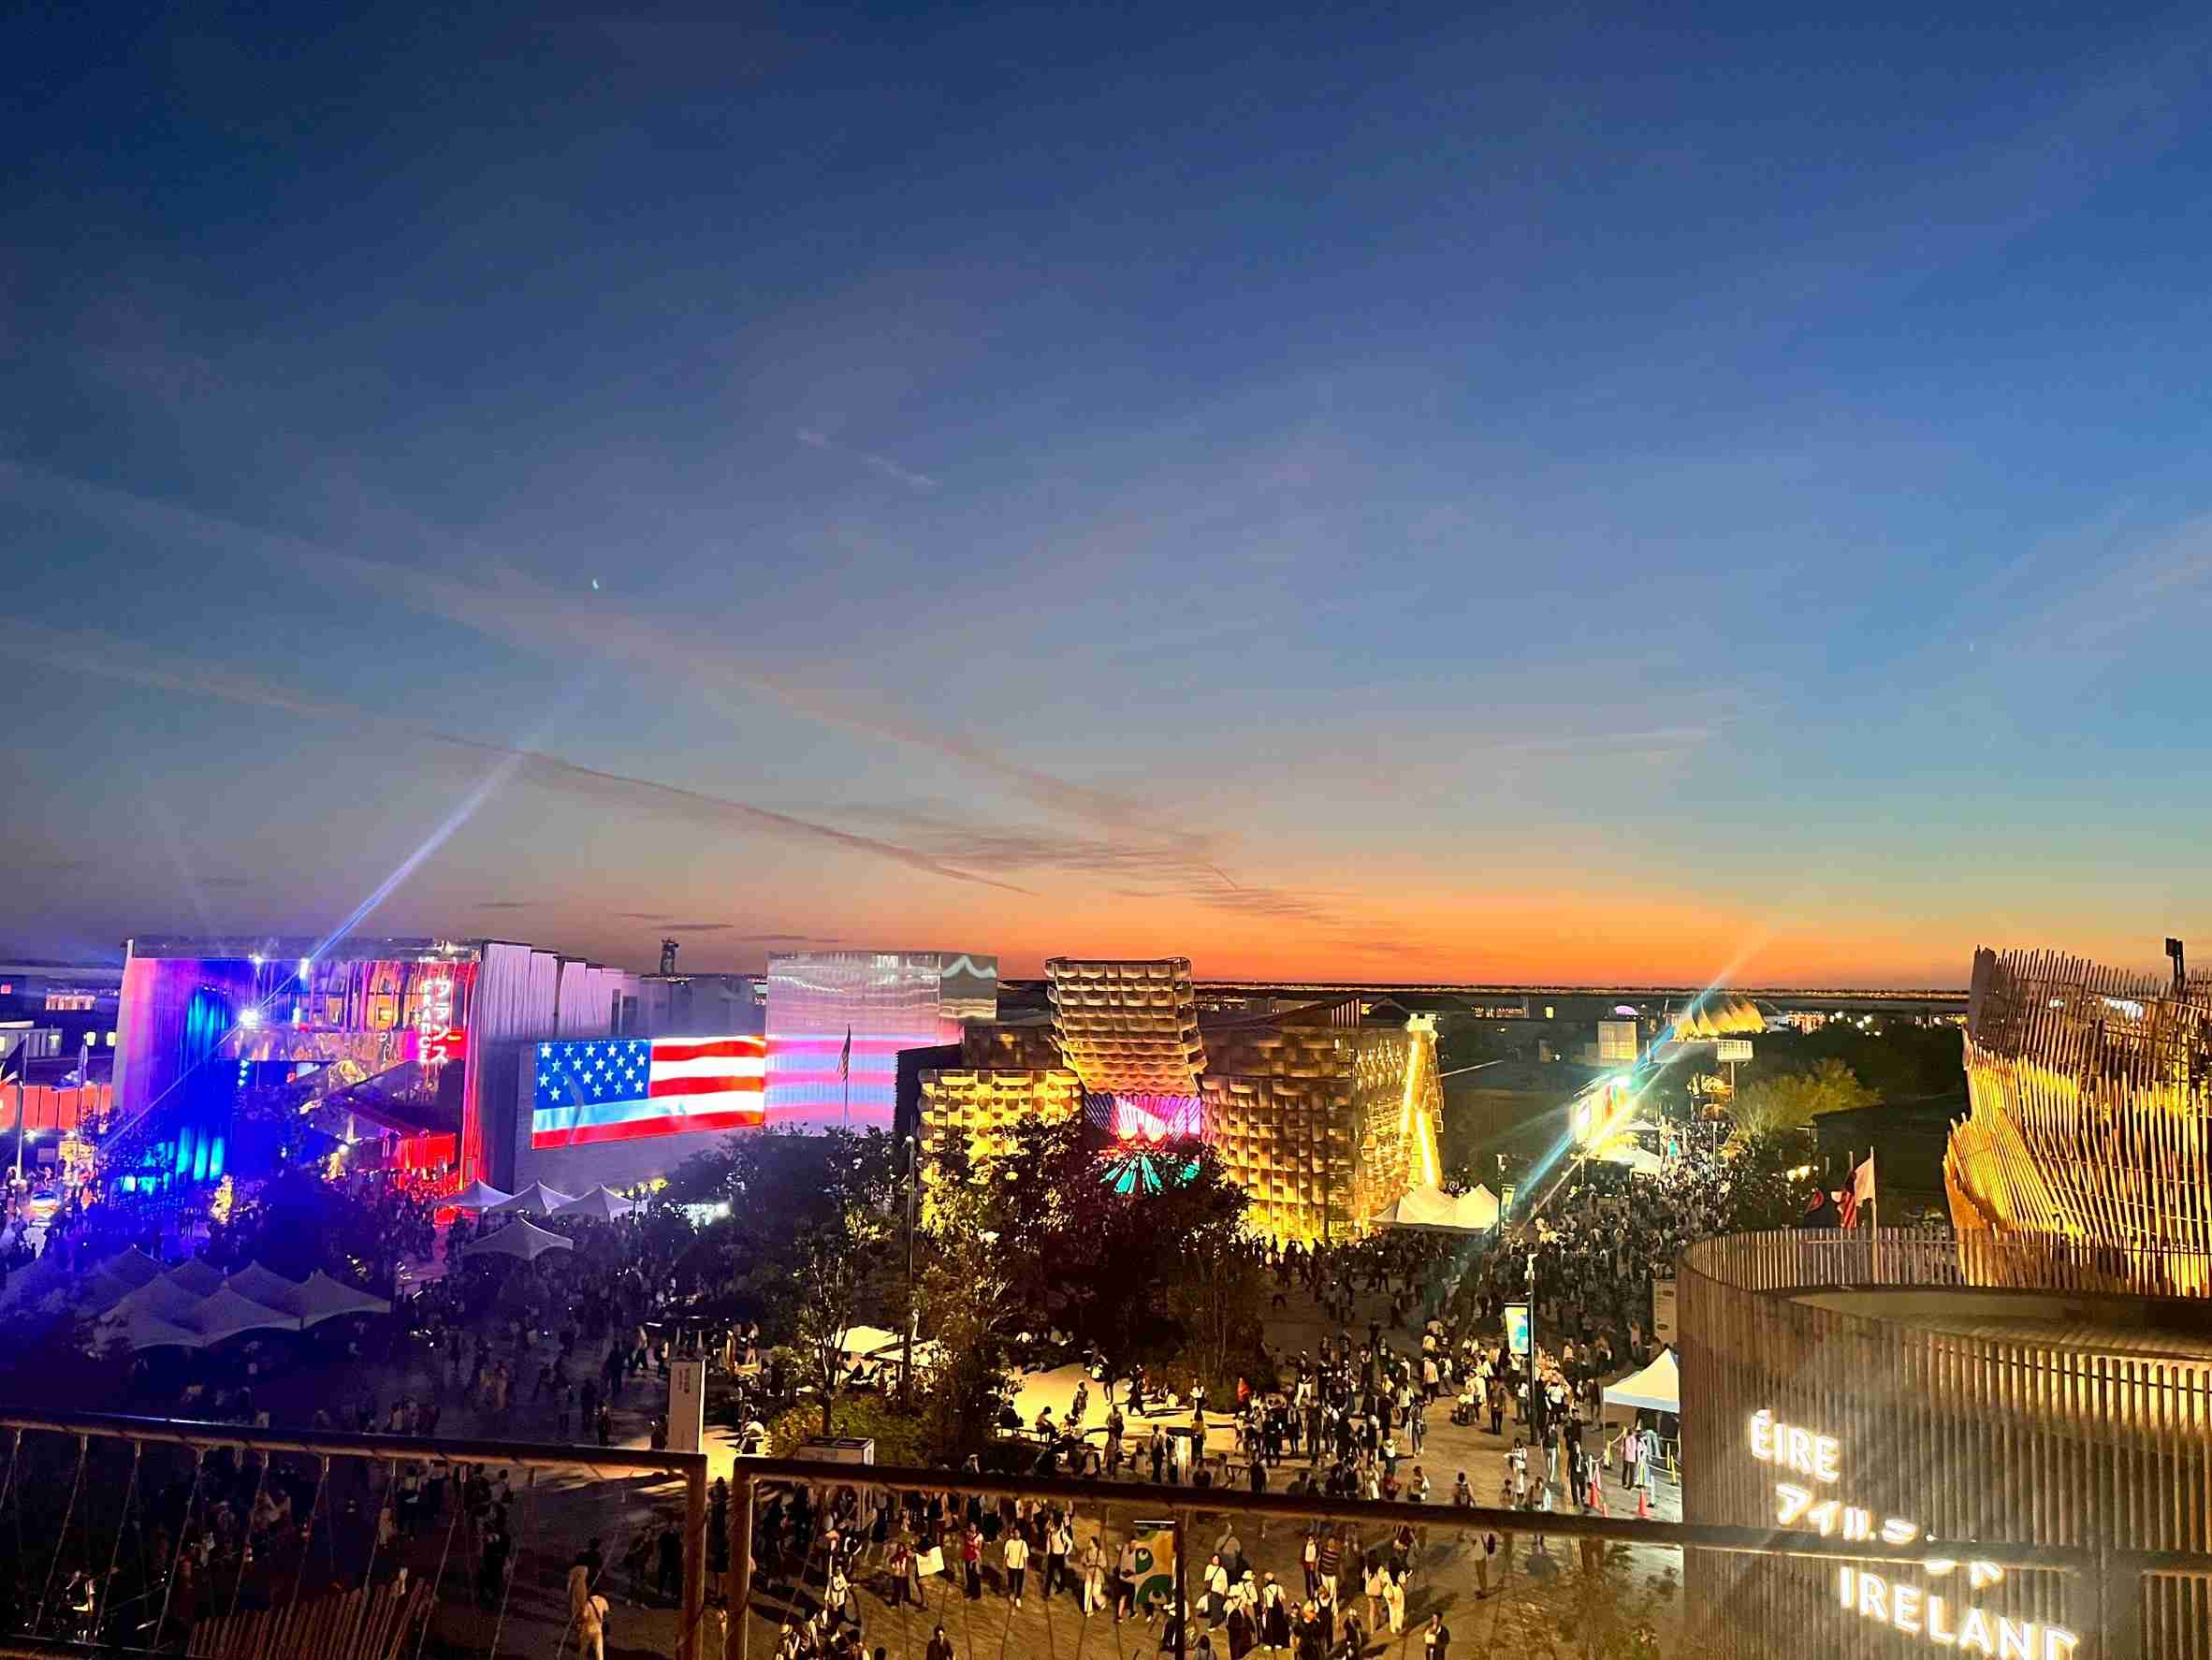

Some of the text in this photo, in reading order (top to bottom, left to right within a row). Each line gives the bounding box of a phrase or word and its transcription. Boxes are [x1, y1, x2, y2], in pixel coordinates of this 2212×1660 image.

[431, 979, 450, 1064] フランス
[1751, 1408, 1841, 1483] ÉIRE
[1840, 1565, 2079, 1660] IRELAND
